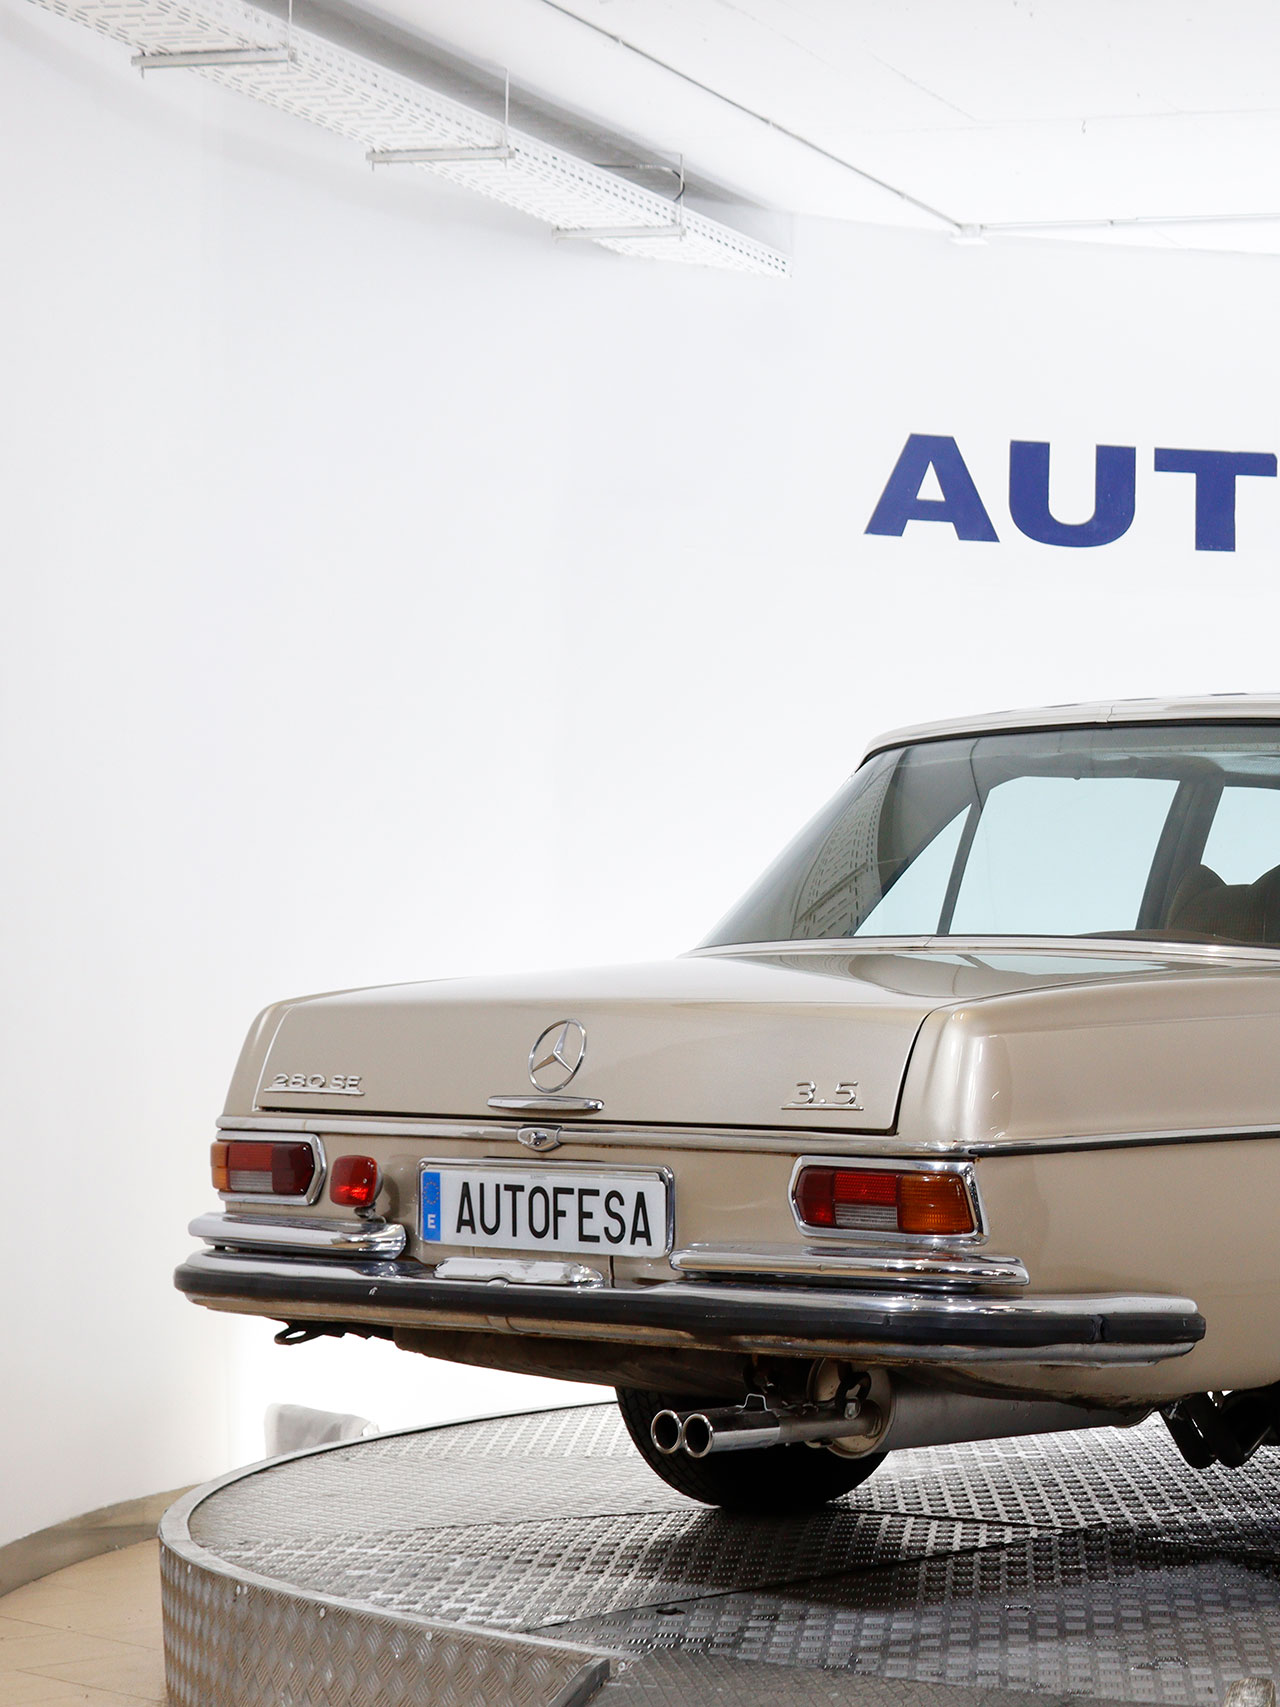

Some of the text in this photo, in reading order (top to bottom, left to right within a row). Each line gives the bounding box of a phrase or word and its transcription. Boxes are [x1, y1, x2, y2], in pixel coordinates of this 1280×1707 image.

[271, 1073, 362, 1091] 280 SE
[791, 1080, 859, 1105] 3.5
[427, 1213, 437, 1230] E
[456, 1181, 652, 1247] AUTOFESA
